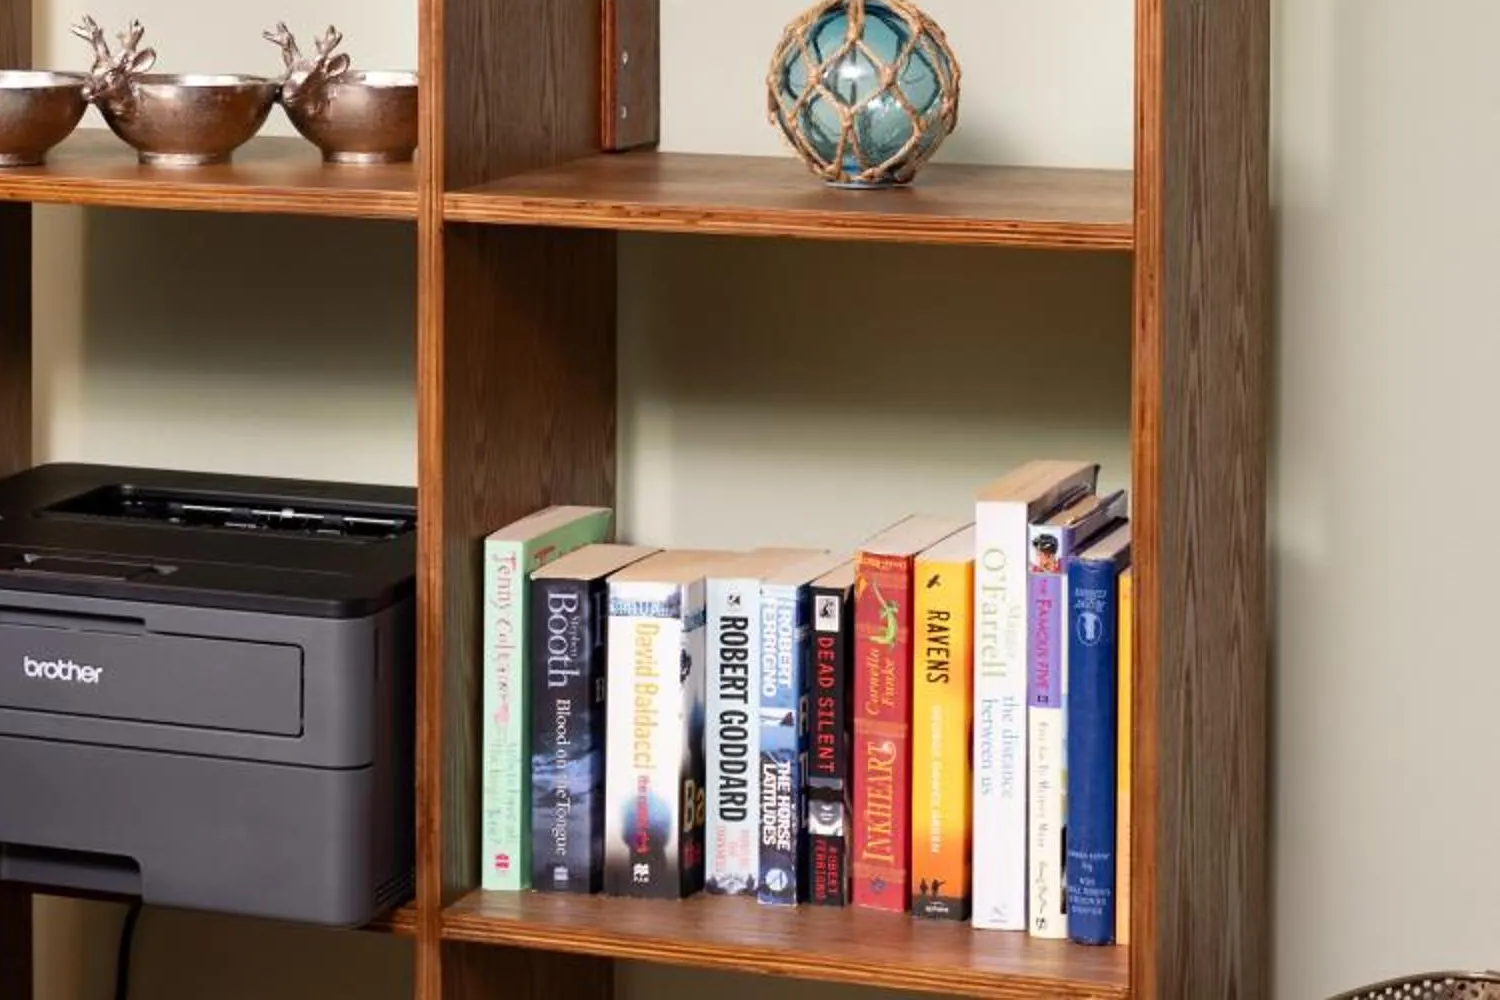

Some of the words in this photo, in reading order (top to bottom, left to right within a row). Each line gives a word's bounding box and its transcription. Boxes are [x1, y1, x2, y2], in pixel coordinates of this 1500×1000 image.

[490, 551, 516, 609] Jenny
[547, 591, 581, 688] Booth
[569, 616, 581, 657] Stephen
[635, 623, 660, 676] David
[762, 601, 777, 698] FERRIGNO
[778, 607, 793, 688] ROBERT
[926, 610, 952, 684] RAVENS
[1036, 599, 1053, 658] FAMOUS
[23, 655, 103, 684] brother
[719, 616, 749, 704] ROBERT
[817, 636, 835, 687] DEAD
[555, 699, 571, 745] Blood
[633, 683, 660, 769] Baldacci
[816, 697, 836, 772] SILENT
[981, 699, 1000, 770] between
[1001, 695, 1020, 722] the
[555, 750, 566, 769] on
[719, 711, 749, 821] GODDARD
[777, 761, 791, 792] THE
[981, 776, 994, 797] us
[1000, 729, 1020, 799] distance
[551, 798, 571, 856] Tongue
[763, 762, 778, 846] LATITUDES
[777, 796, 792, 850] HORSE
[862, 741, 897, 863] INKHEART
